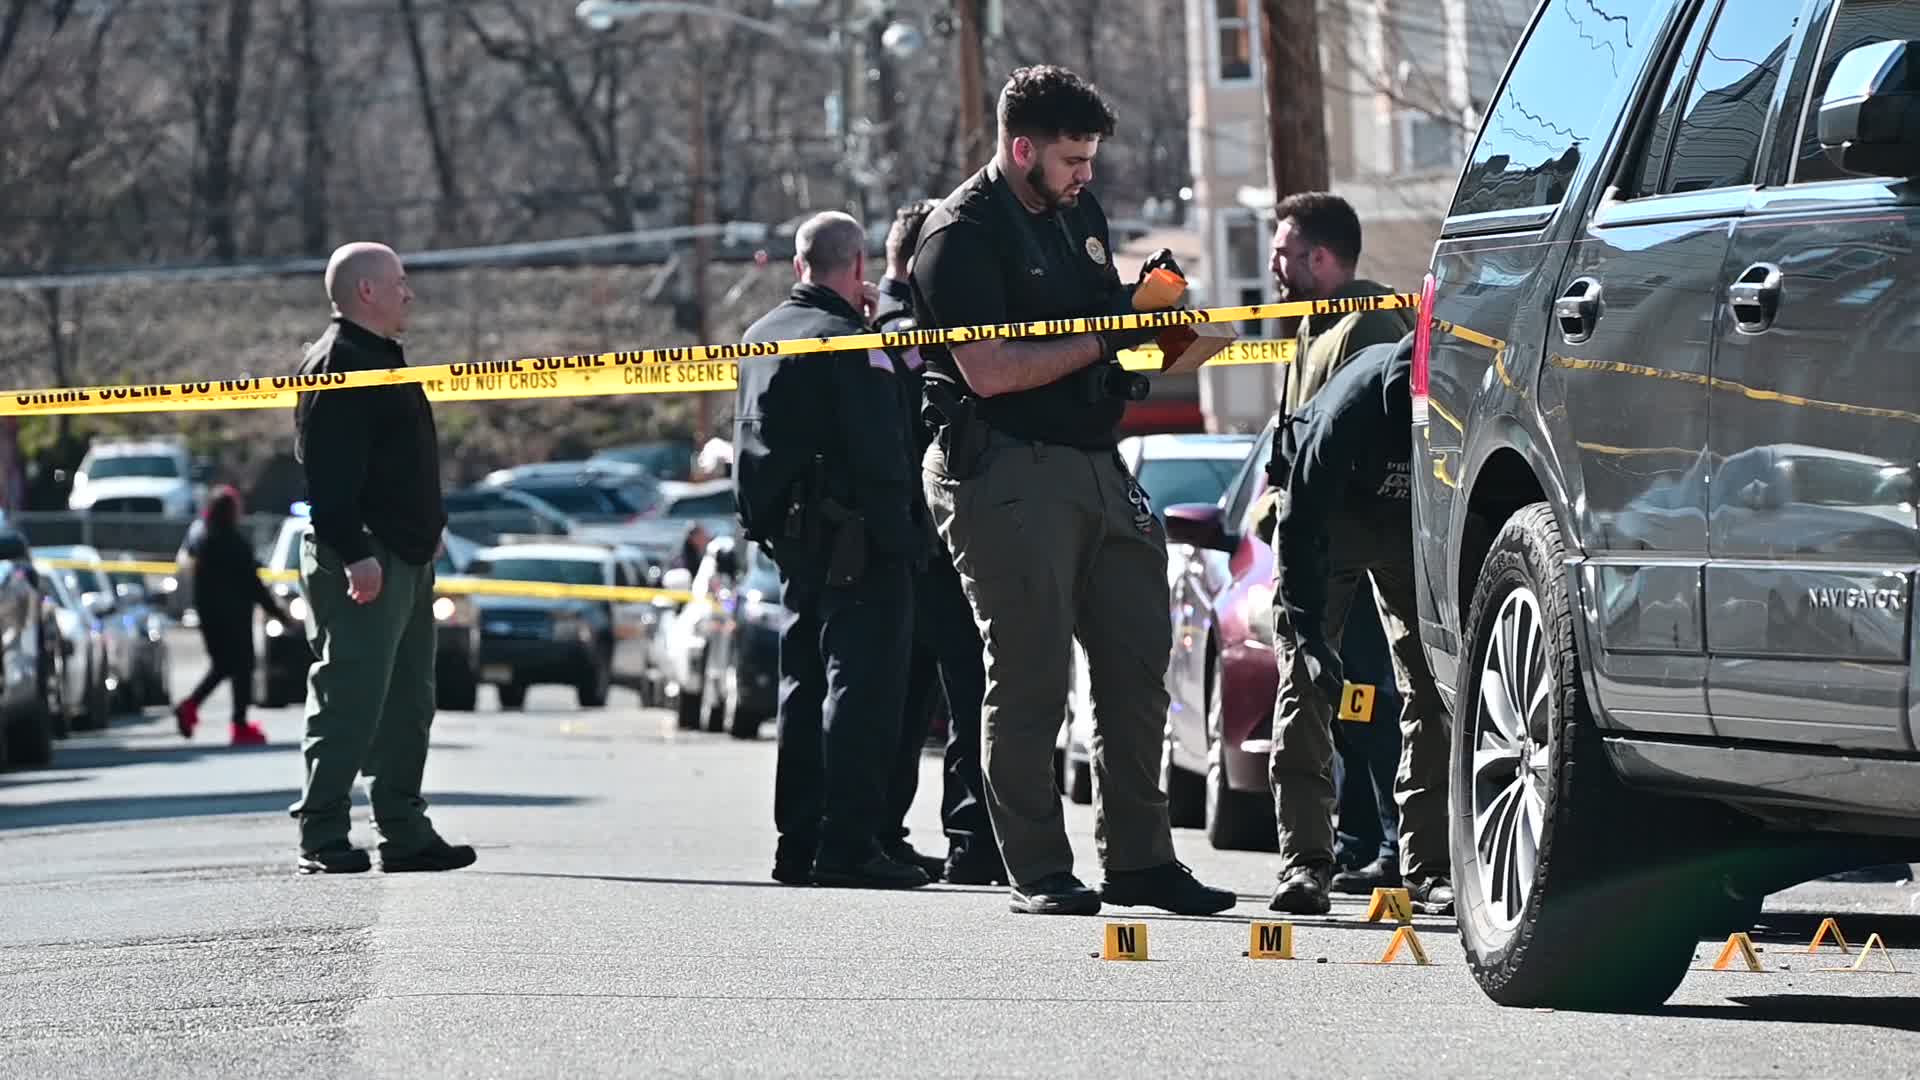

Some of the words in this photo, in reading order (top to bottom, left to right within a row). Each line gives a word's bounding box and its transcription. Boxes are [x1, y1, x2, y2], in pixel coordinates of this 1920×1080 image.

[1241, 342, 1289, 360] SCENE
[509, 371, 558, 389] CROSS
[624, 365, 672, 384] CRIME
[677, 363, 724, 382] SCENE
[1808, 588, 1899, 609] NAVIGATOR
[1350, 689, 1364, 713] C
[1117, 927, 1136, 953] N
[1259, 926, 1282, 951] M
